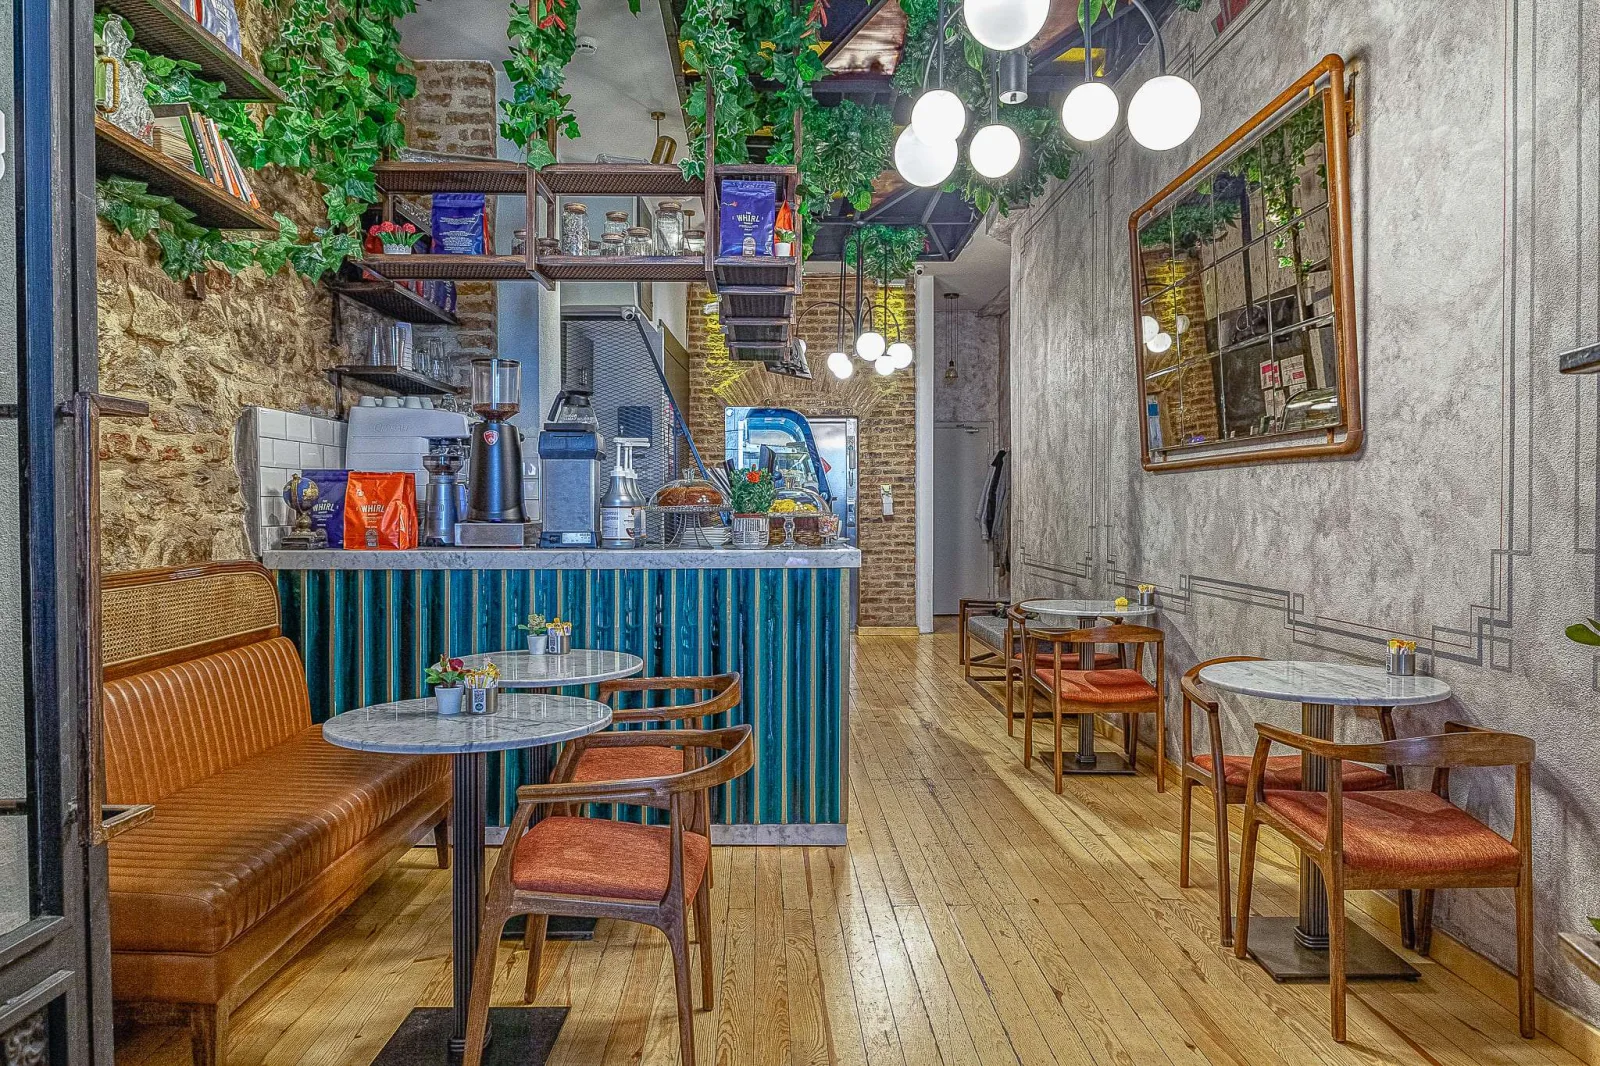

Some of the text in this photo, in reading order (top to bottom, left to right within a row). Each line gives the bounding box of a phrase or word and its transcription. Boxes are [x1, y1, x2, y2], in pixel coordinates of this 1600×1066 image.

[736, 214, 760, 222] WHIRL
[312, 503, 335, 512] WHIRL
[361, 504, 384, 513] WHIRL
